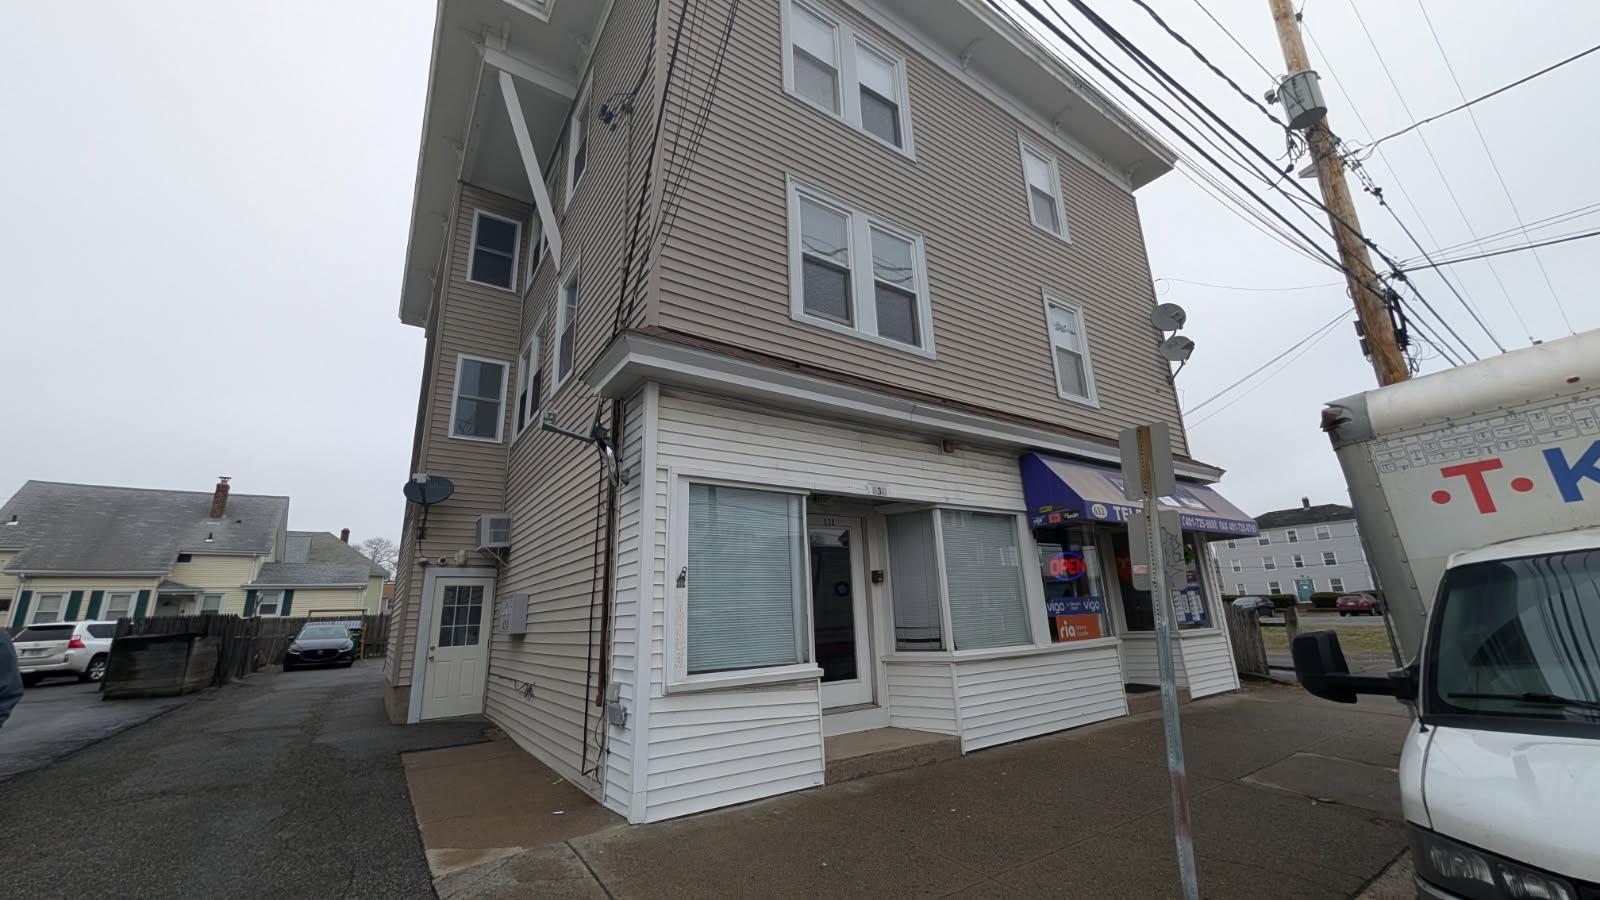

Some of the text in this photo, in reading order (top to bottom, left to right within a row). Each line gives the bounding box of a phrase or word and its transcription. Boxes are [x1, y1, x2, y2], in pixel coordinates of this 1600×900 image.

[1049, 558, 1086, 577] OPEN
[1047, 600, 1065, 614] vigo
[1083, 598, 1100, 612] vigo
[1060, 620, 1076, 639] ria
